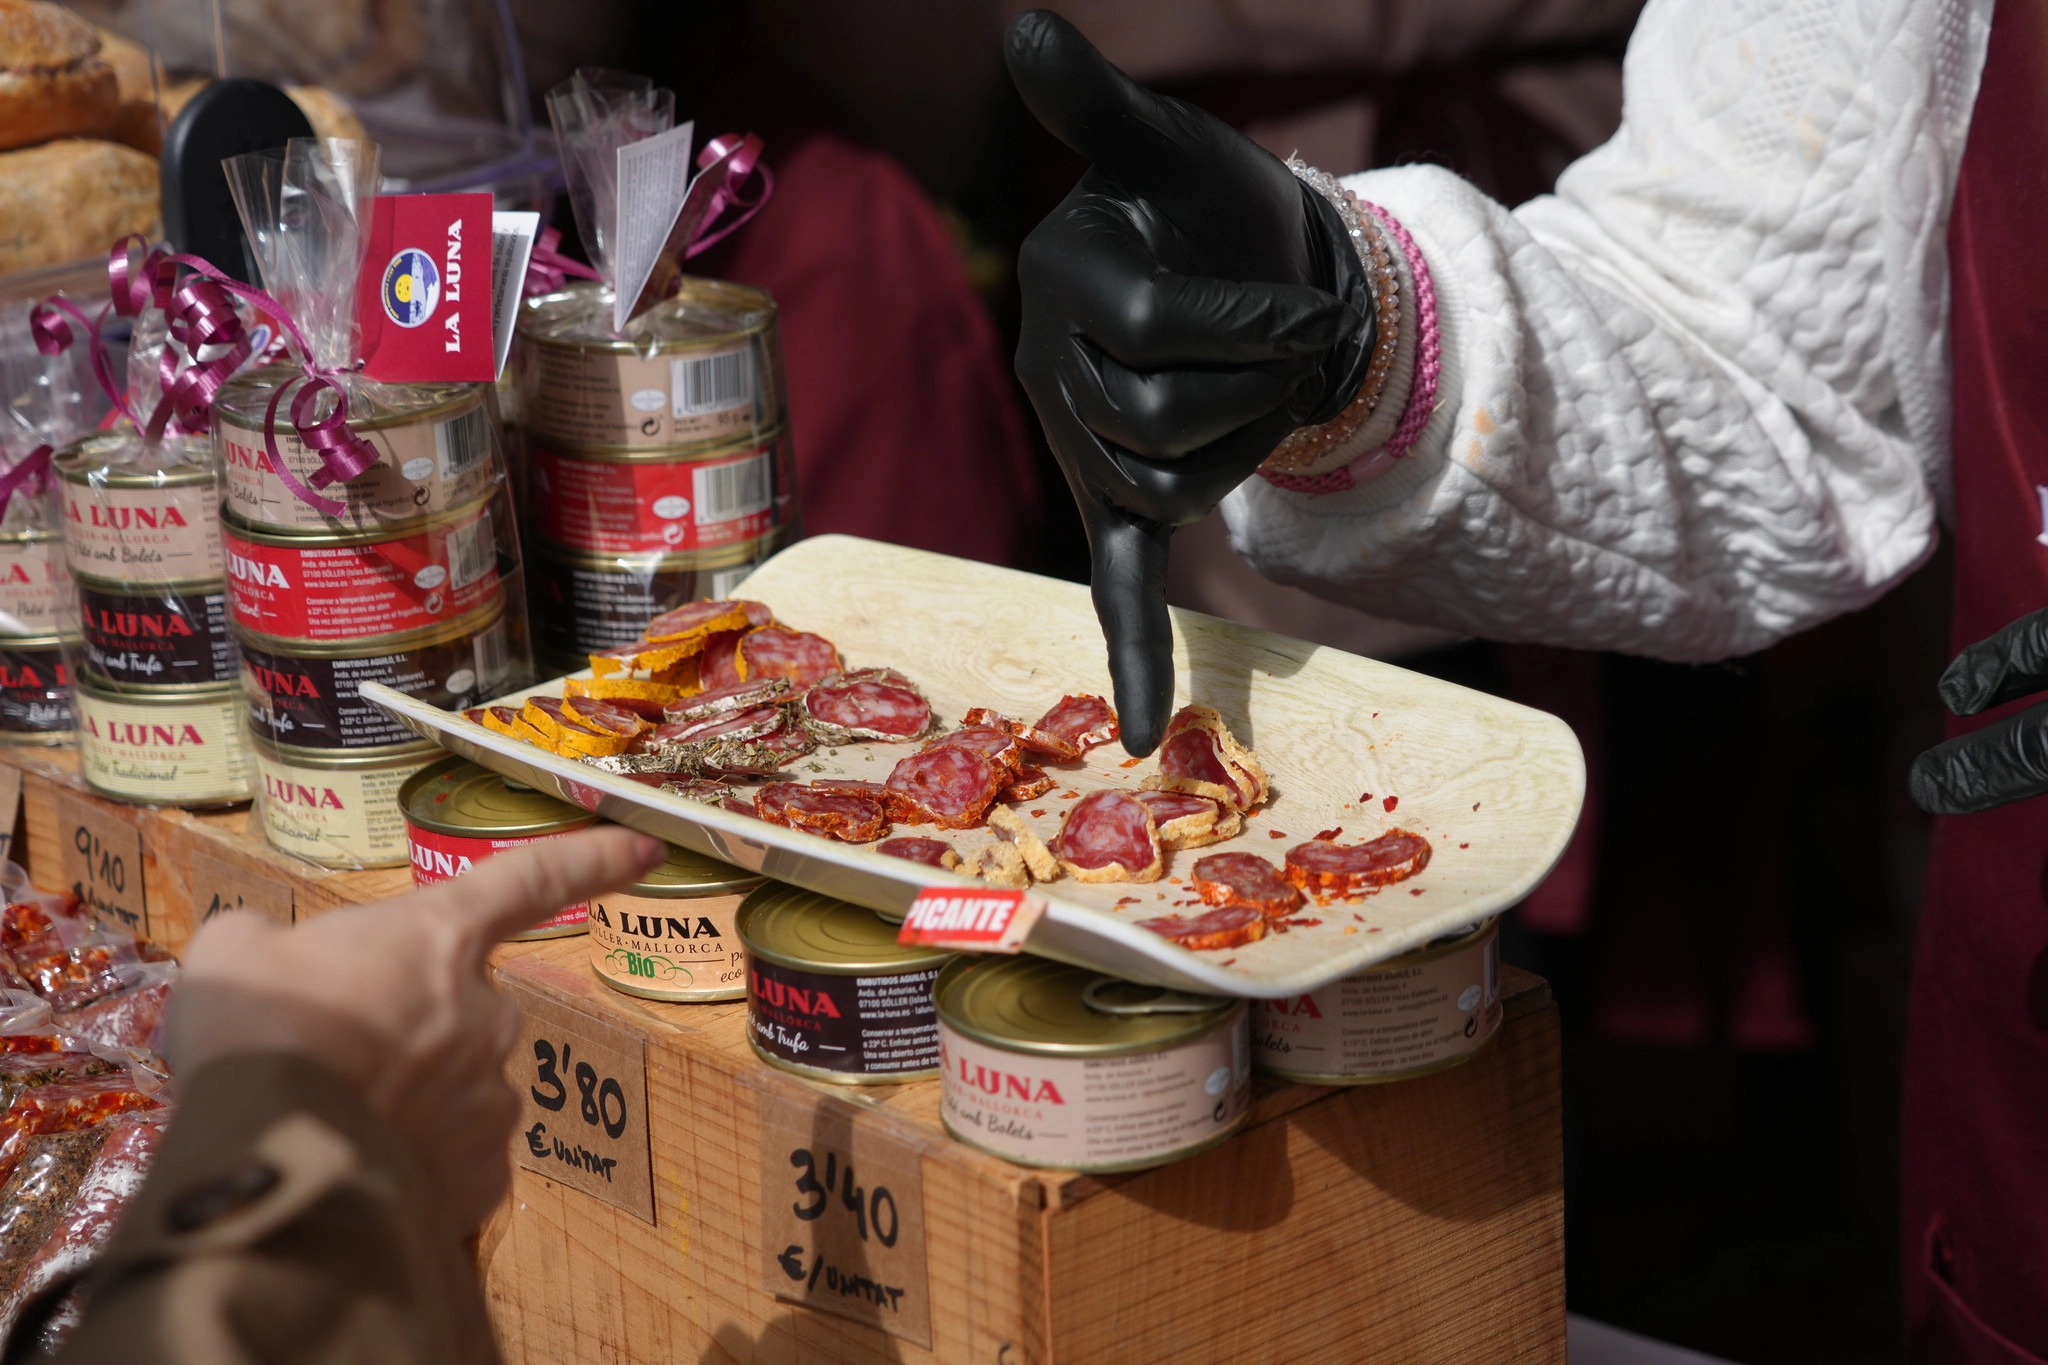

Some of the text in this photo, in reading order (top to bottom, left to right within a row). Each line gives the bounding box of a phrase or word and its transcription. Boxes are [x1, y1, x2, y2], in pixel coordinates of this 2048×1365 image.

[446, 218, 463, 353] LA LUNA
[225, 439, 276, 474] UNA
[90, 505, 188, 530] LUNA
[300, 549, 336, 557] EMBUTIDOS
[0, 563, 30, 584] A
[226, 551, 291, 589] LUNA
[101, 610, 193, 637] LUNA
[332, 659, 369, 669] EMBUTIDOS
[252, 662, 320, 698] UNA
[108, 721, 204, 746] LUNA
[265, 774, 345, 810] LUNA
[408, 837, 475, 877] LUNA
[492, 839, 528, 848] EMBUTIDOS
[75, 826, 125, 894] 9'10
[562, 913, 574, 921] tres
[588, 900, 722, 940] LA LUNA
[904, 897, 1014, 932] PICANTE
[632, 939, 724, 954] MALLORCA
[752, 970, 842, 1019] LUNA
[856, 976, 898, 986] EMBUTIDOS
[858, 984, 924, 997] Avda. de Asturias, 4
[859, 999, 880, 1008] 07100
[881, 997, 907, 1007] SÓLLER
[756, 1022, 809, 1054] amb Trufa
[862, 1029, 894, 1037] Conservar
[889, 1038, 911, 1047] Enfriar
[912, 1036, 930, 1044] antes
[864, 1051, 877, 1059] Una
[891, 1048, 914, 1057] abierto
[870, 1061, 900, 1070] consumir
[902, 1059, 920, 1068] antes
[921, 1057, 929, 1066] de
[931, 1056, 941, 1064] tre
[530, 1038, 627, 1140] 3'80
[959, 1056, 1066, 1106] LUNA
[525, 1122, 552, 1158] €
[987, 1113, 1034, 1140] Bolets
[790, 1148, 899, 1249] 3'40
